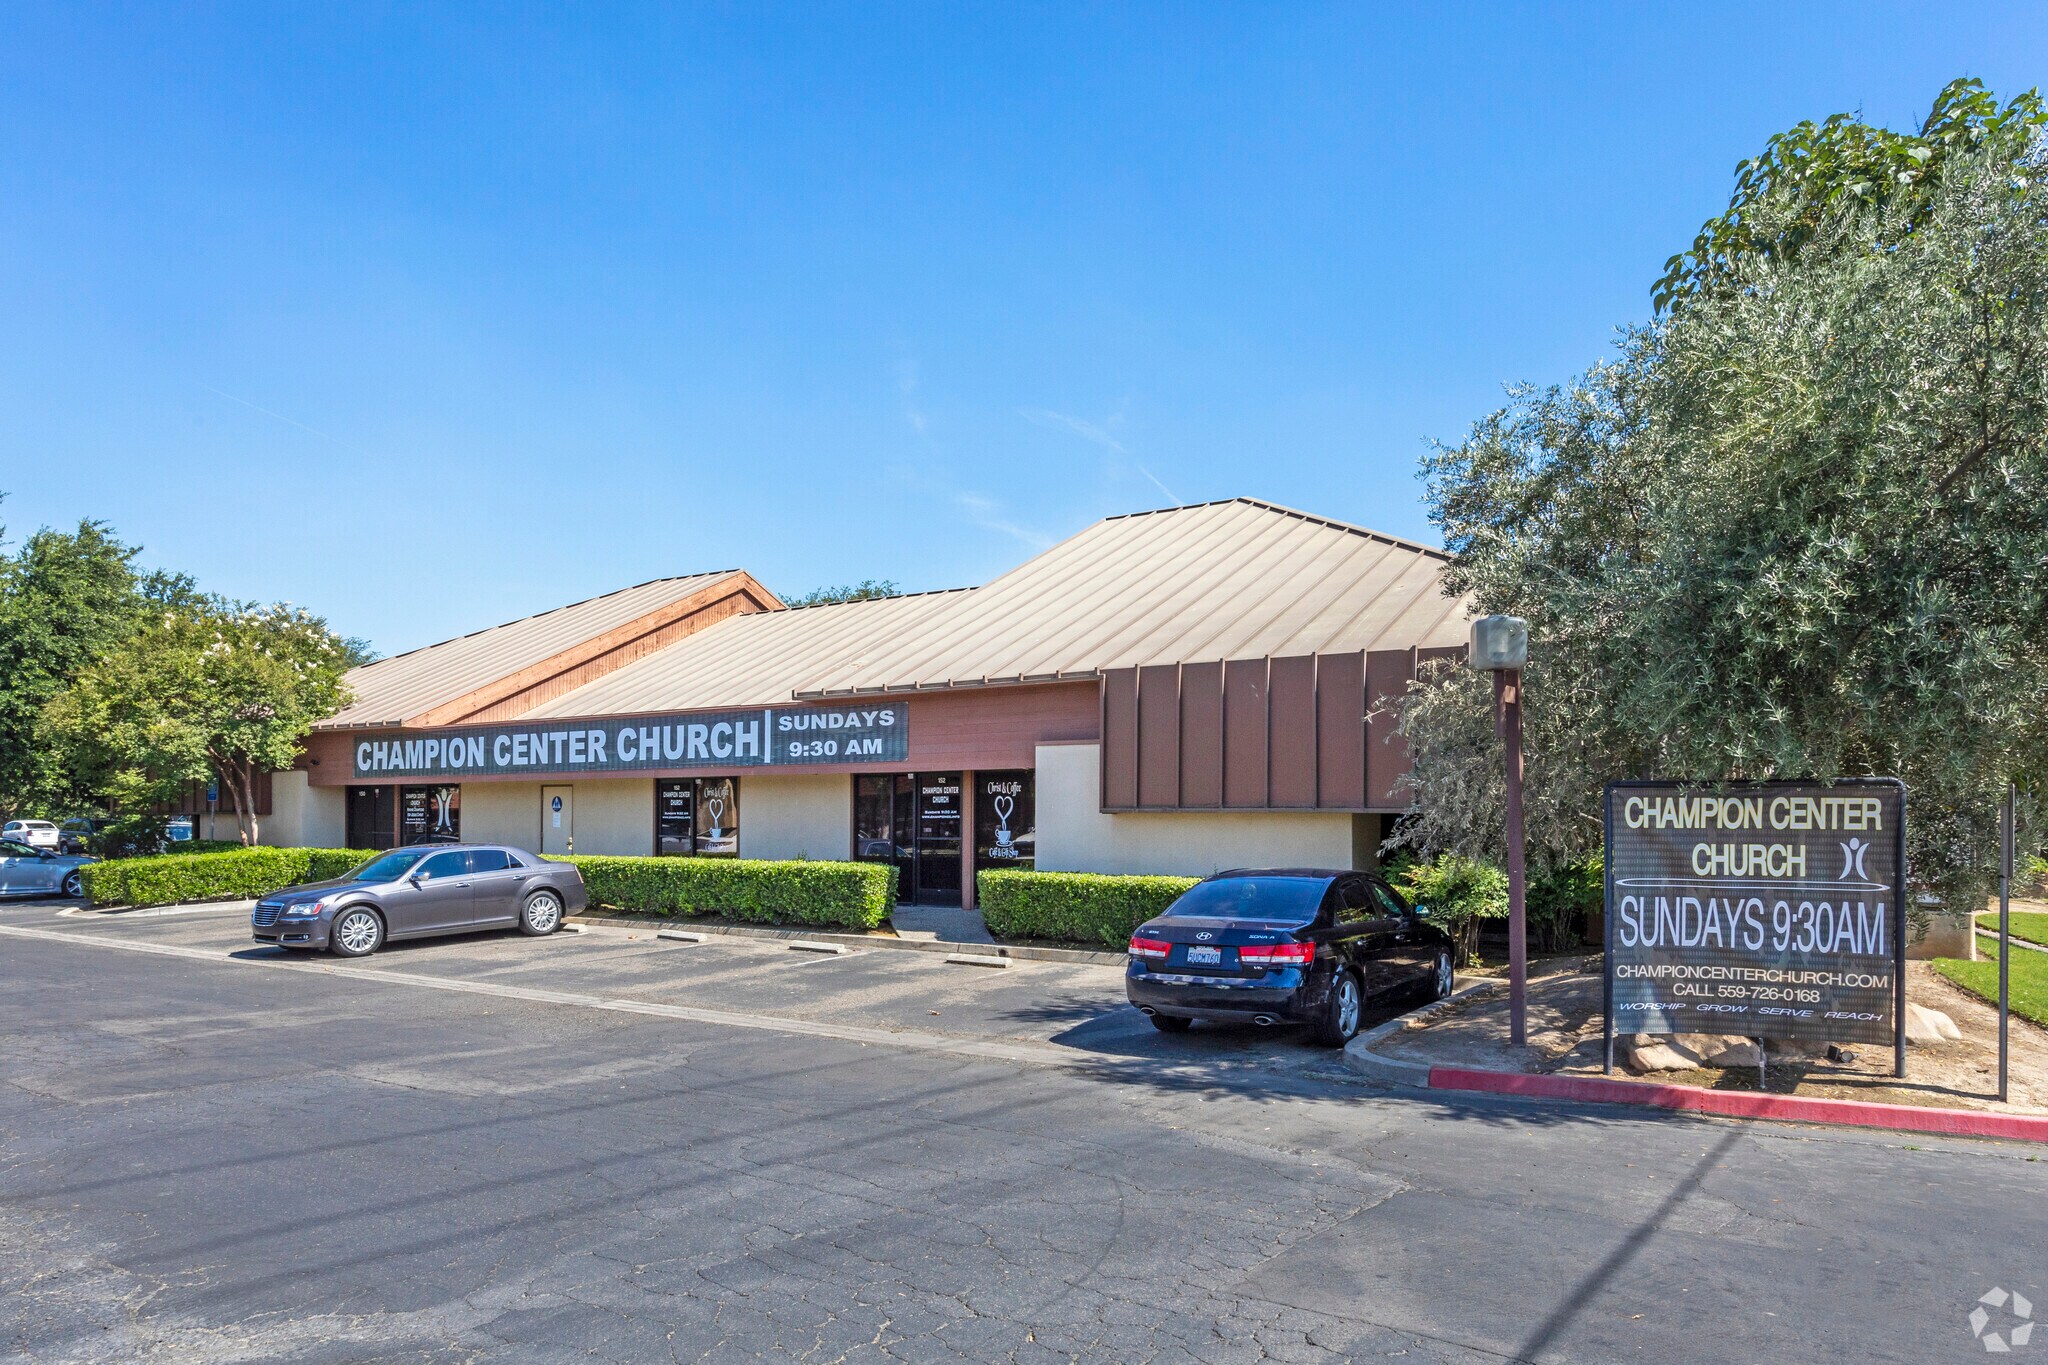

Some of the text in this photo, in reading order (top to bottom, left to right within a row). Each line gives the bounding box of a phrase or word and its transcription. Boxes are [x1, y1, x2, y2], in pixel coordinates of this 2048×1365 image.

[778, 710, 895, 732] SUNDAYS
[357, 720, 758, 771] CHAMPION CENTER CHURCH
[789, 738, 882, 757] 9:30 AM
[1624, 796, 1882, 831] CHAMPION CENTER
[1692, 843, 1806, 877] CHURCH
[1619, 895, 1885, 956] SUNDAYS 9:30AM
[1616, 964, 1888, 989] CHAMPIONCENTERCHURCH.COM
[1673, 983, 1820, 1003] CALL 559-726-0168
[1620, 1002, 1883, 1021] WORSHIP GROW SERVE REACH
